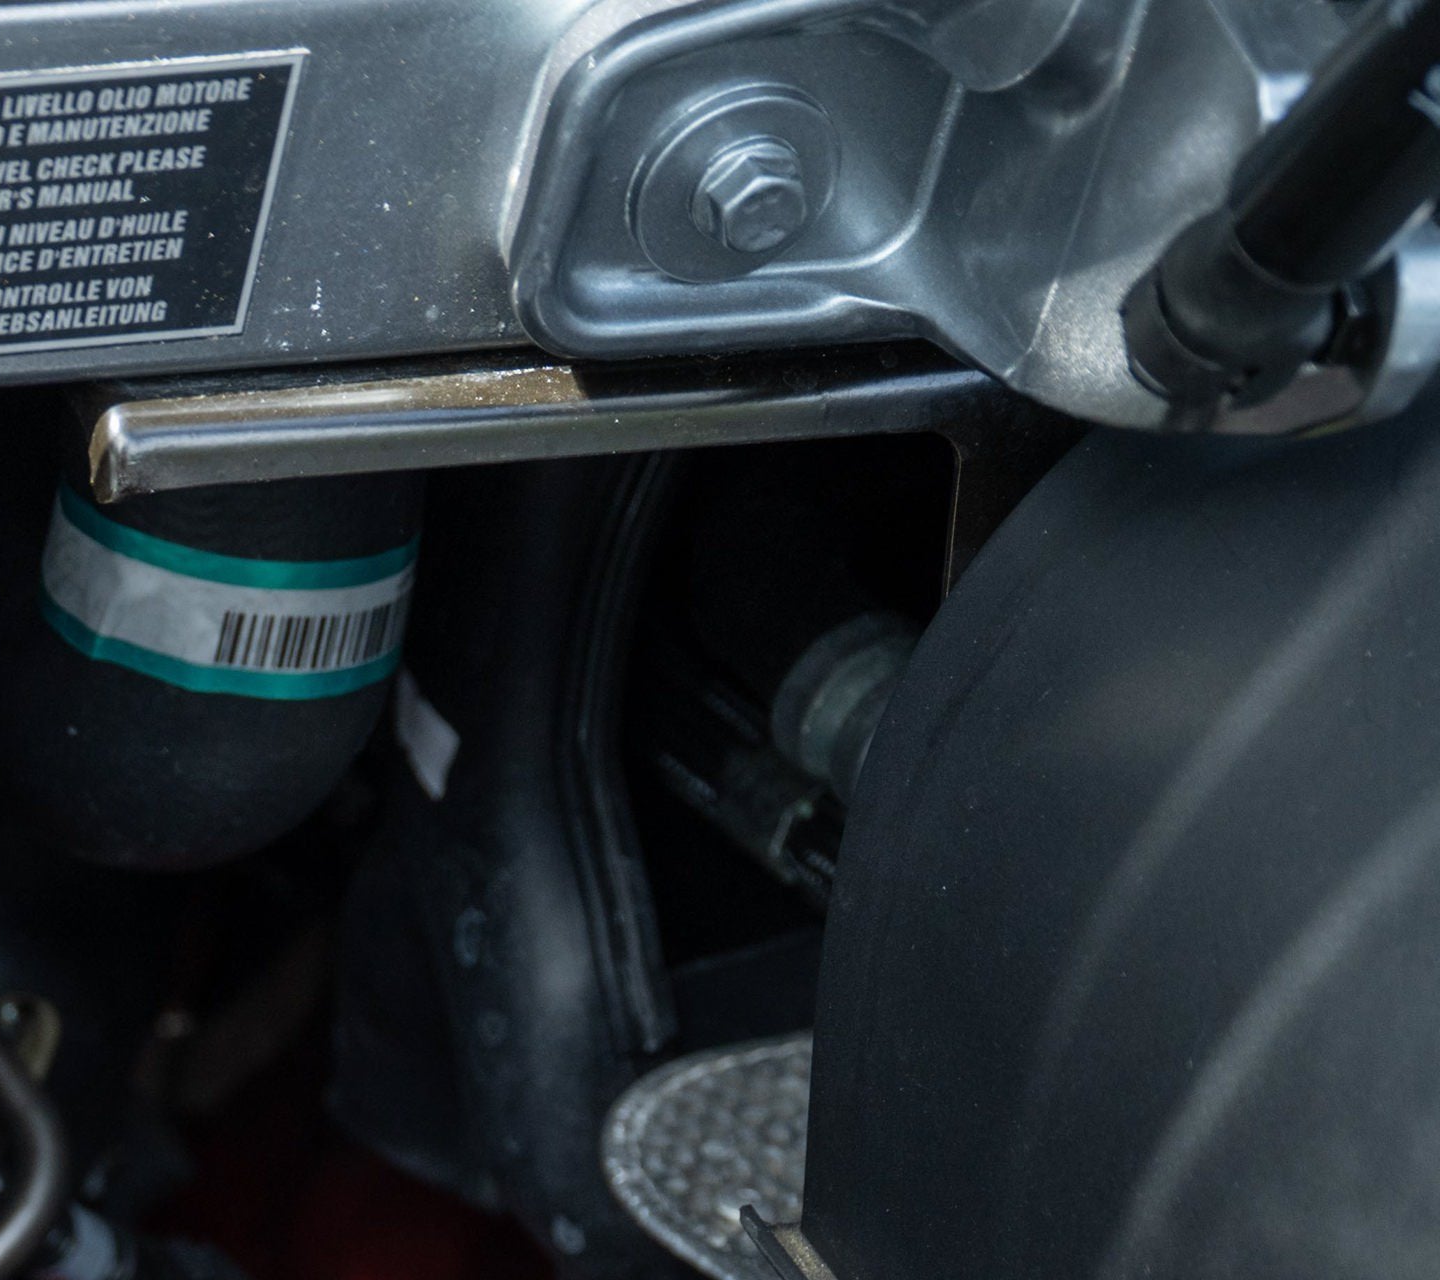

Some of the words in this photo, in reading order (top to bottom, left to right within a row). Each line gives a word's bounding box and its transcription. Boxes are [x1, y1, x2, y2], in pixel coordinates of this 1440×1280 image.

[1, 88, 92, 119] LIVELLO
[97, 85, 150, 112] OLIO
[154, 78, 252, 109] MOTORE
[8, 123, 23, 146] E
[26, 109, 212, 144] MANUTENZIONE
[36, 153, 114, 182] CHECK
[117, 145, 207, 175] PLEASE
[37, 179, 134, 208] MANUAL
[8, 218, 93, 245] NIVEAU
[38, 237, 184, 269] D'ENTRETIEN
[105, 276, 153, 300] VON
